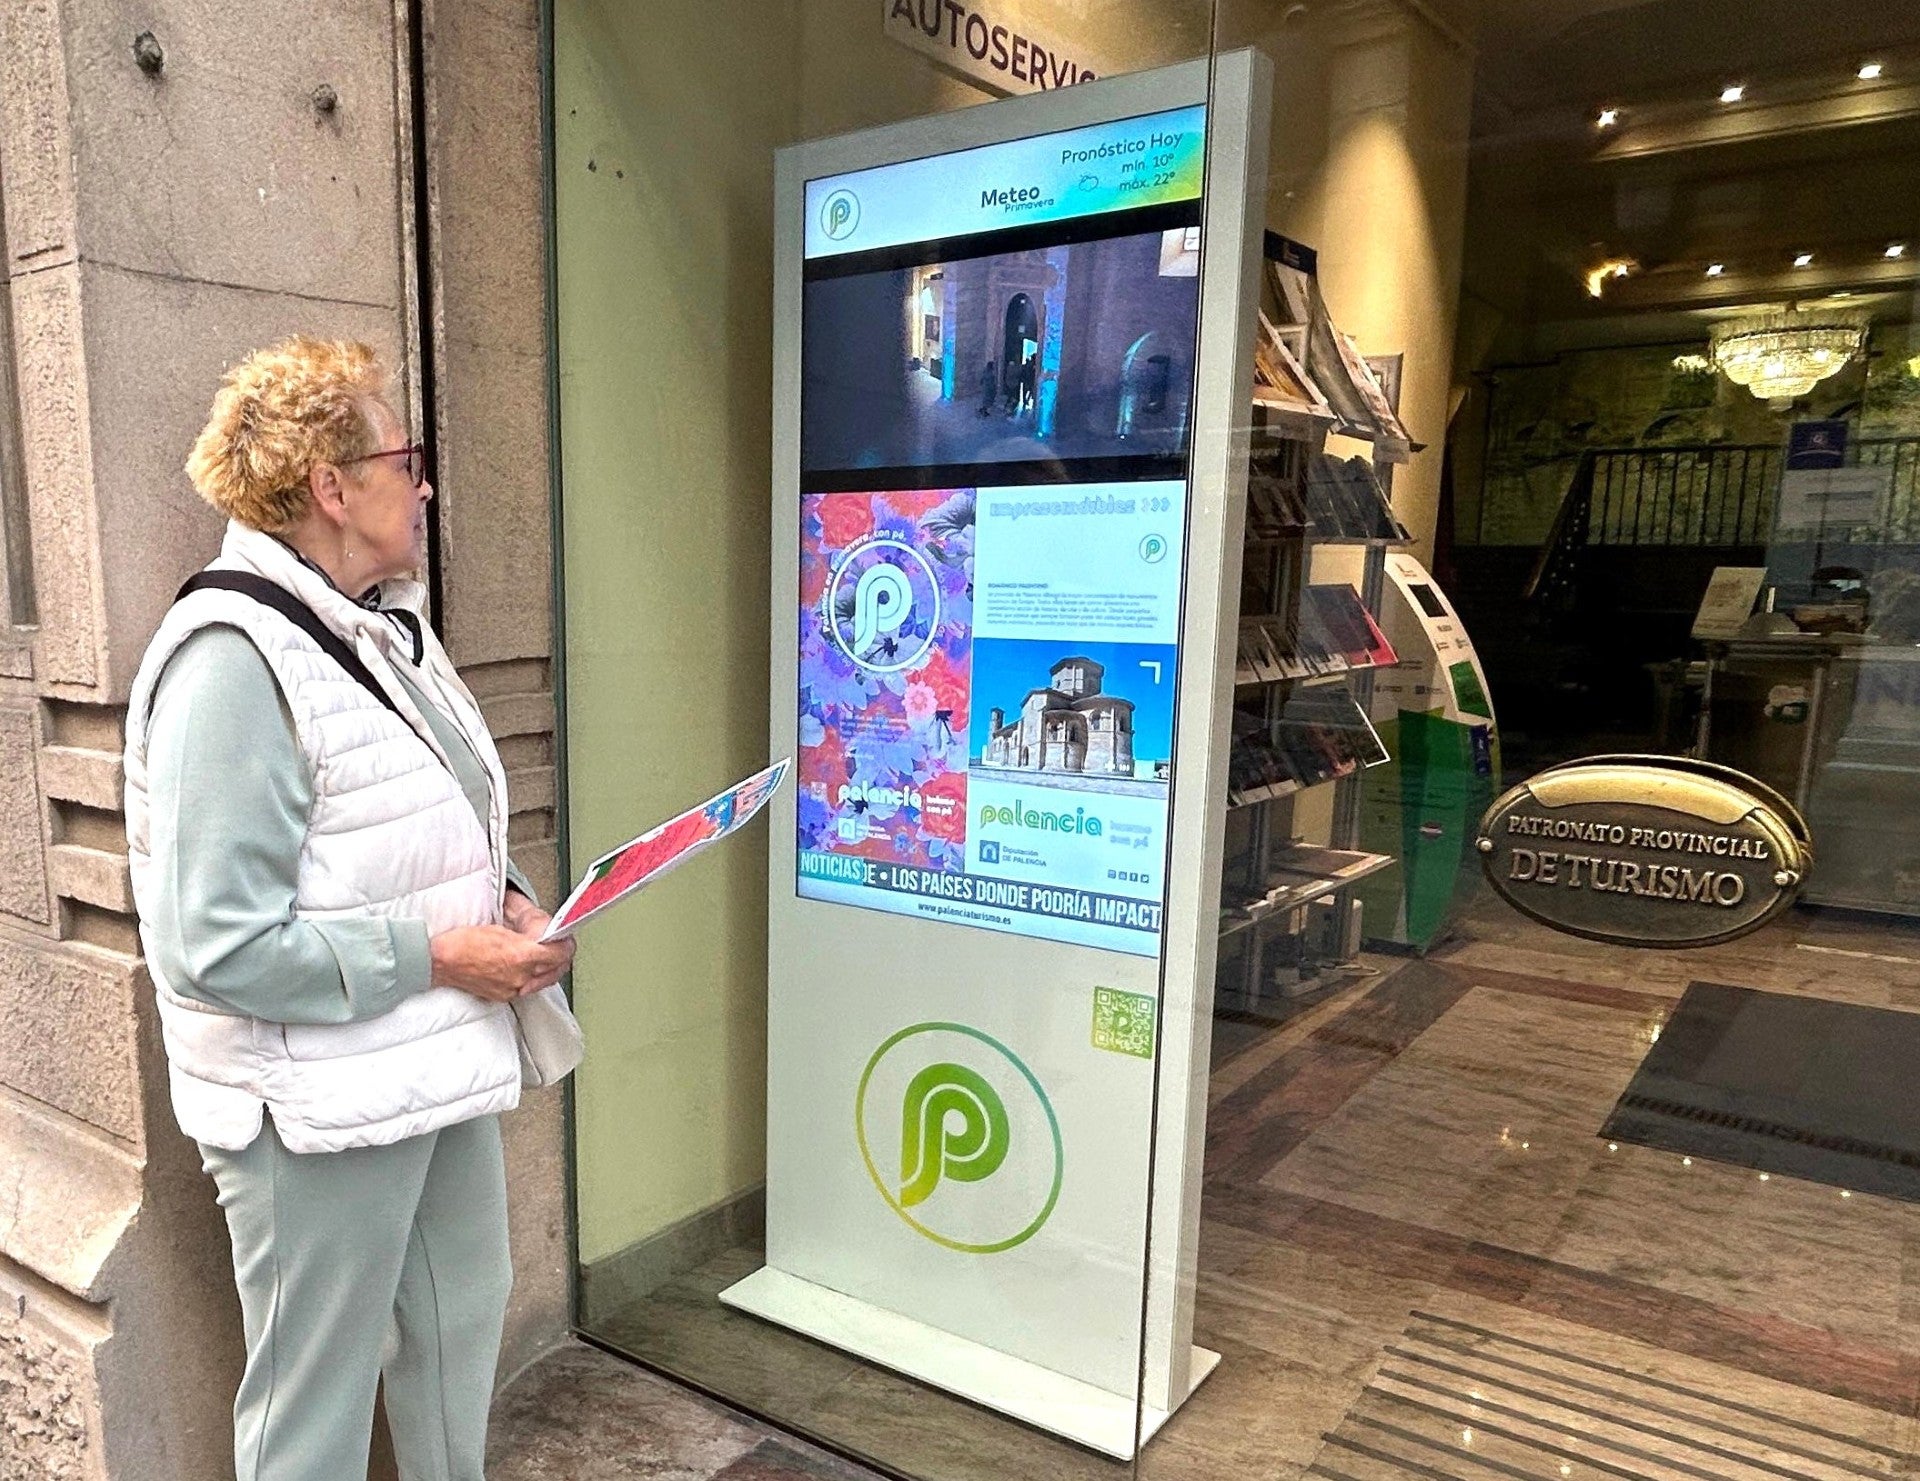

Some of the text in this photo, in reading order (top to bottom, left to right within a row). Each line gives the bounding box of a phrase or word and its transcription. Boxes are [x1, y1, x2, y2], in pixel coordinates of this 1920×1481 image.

[1061, 132, 1184, 165] Pronóstico Hoy
[981, 185, 1040, 208] Meteo
[1004, 198, 1055, 214] Primavera
[979, 799, 1103, 836] palencia
[1507, 815, 1769, 860] PATRONATO PROVINCIAL
[800, 853, 863, 880] NOTICIAS
[1509, 849, 1744, 906] DE TURISMO
[891, 867, 918, 891] LOS
[921, 870, 972, 899] PAÍSES
[976, 878, 1029, 909] DONDE
[1031, 889, 1091, 918] PODRÍA
[918, 902, 1012, 925] www.palenciaturismo.es
